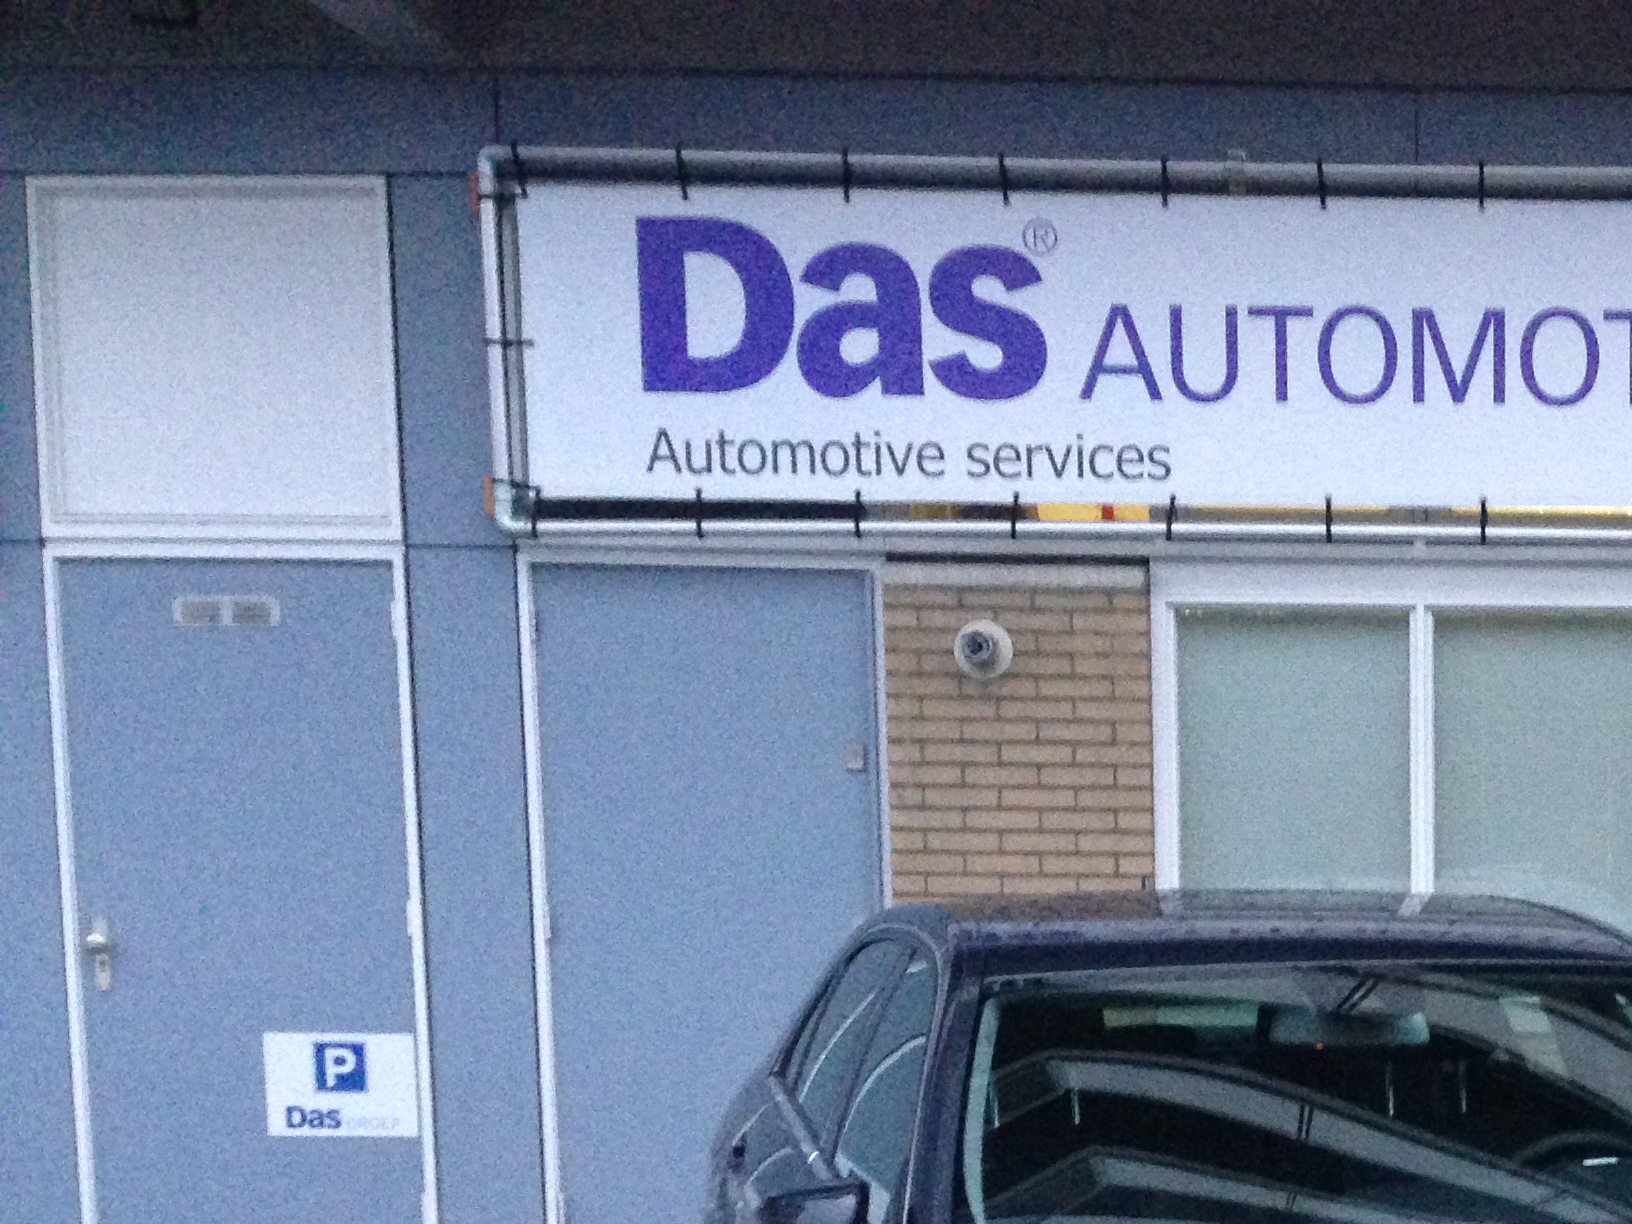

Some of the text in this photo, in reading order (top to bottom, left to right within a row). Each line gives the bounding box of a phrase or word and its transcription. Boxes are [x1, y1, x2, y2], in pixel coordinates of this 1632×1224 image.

[636, 216, 1048, 401] Das
[646, 427, 1172, 481] Automotive services
[324, 1046, 357, 1089] P
[285, 1105, 342, 1130] Das
